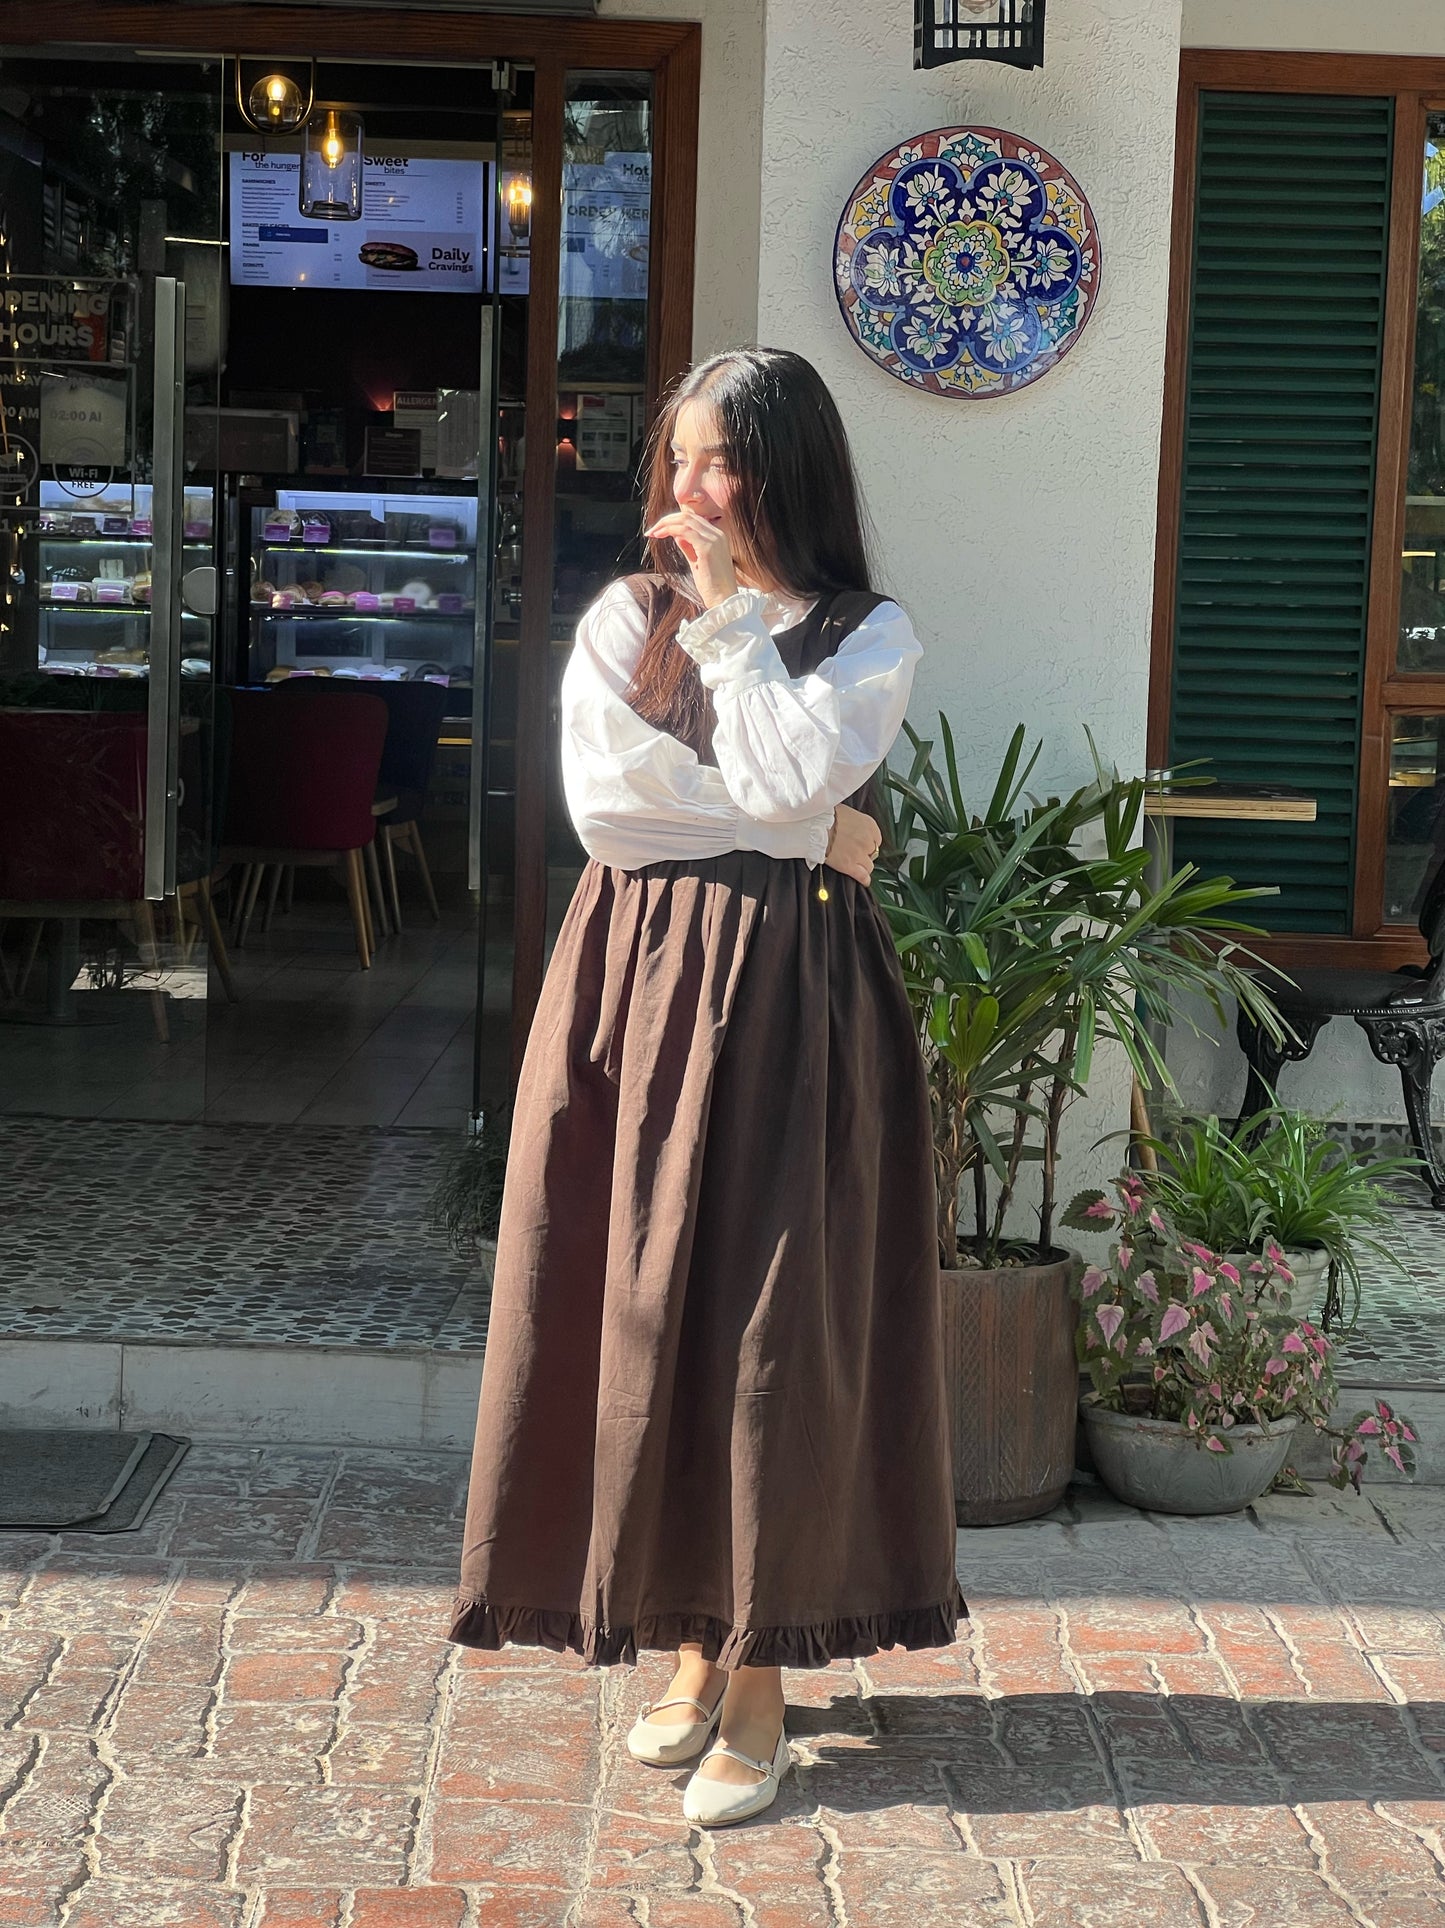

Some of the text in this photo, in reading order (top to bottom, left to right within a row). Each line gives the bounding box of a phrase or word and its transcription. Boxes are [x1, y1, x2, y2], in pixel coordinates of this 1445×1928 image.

[242, 152, 266, 162] For
[363, 156, 409, 168] Sweet
[255, 161, 270, 169] the
[384, 165, 405, 175] bites
[623, 163, 650, 176] Hot
[432, 247, 471, 264] Daily
[428, 260, 474, 274] Cravings
[0, 289, 109, 316] PENING
[0, 322, 94, 347] HOURS
[18, 407, 40, 420] AM
[69, 467, 98, 479] Wi-Fi
[72, 480, 95, 489] FREE
